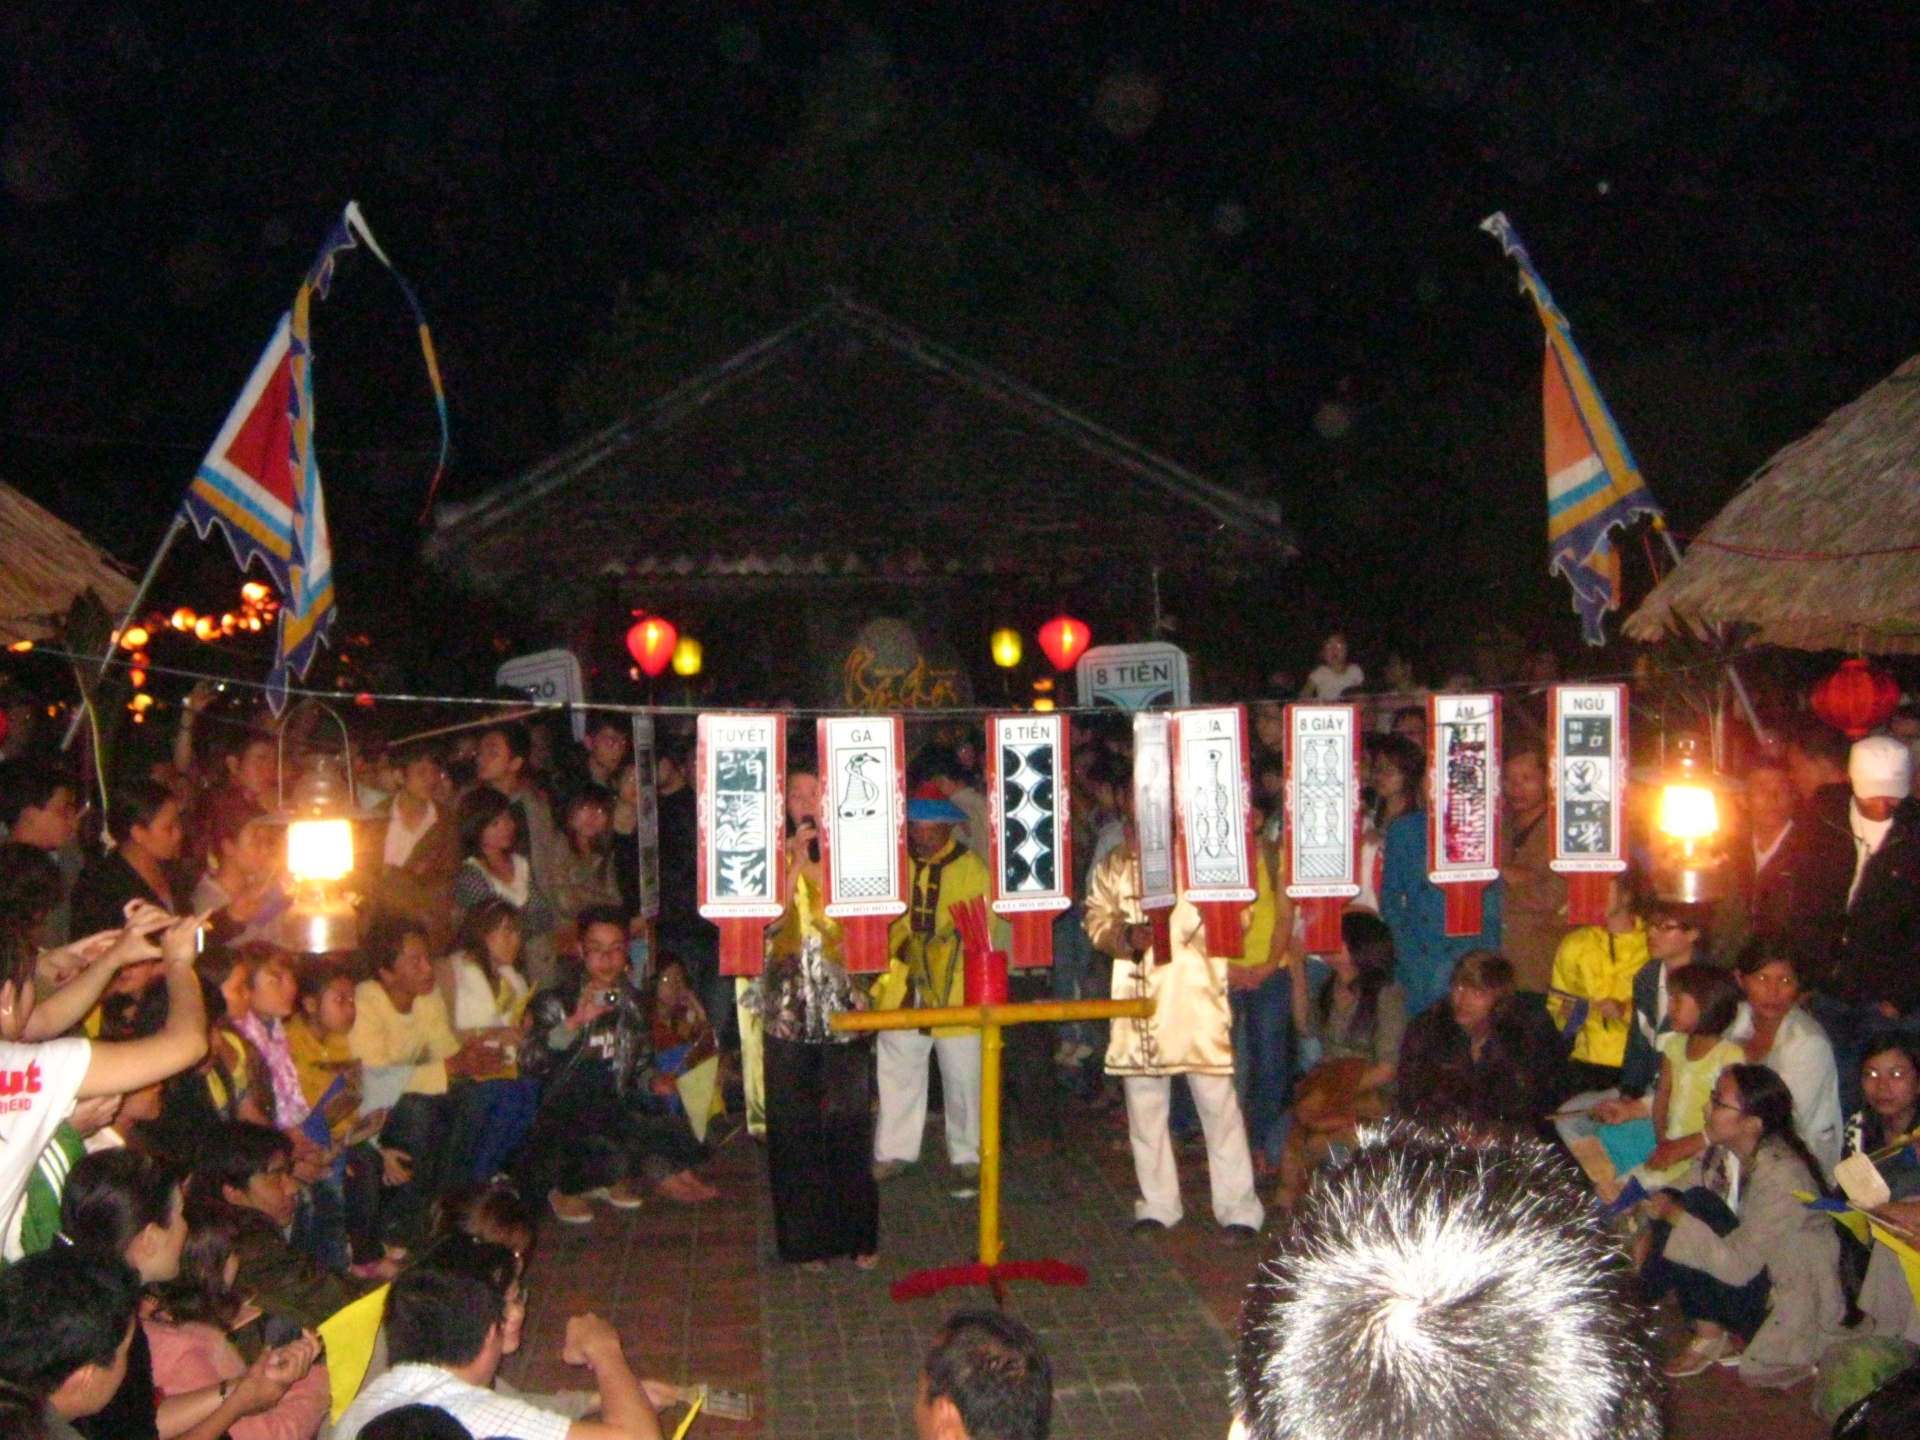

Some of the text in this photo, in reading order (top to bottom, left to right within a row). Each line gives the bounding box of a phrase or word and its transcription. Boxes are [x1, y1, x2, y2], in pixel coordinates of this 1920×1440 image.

[1096, 668, 1107, 685] 8
[1300, 717, 1308, 731] 8
[1004, 727, 1012, 740] 8
